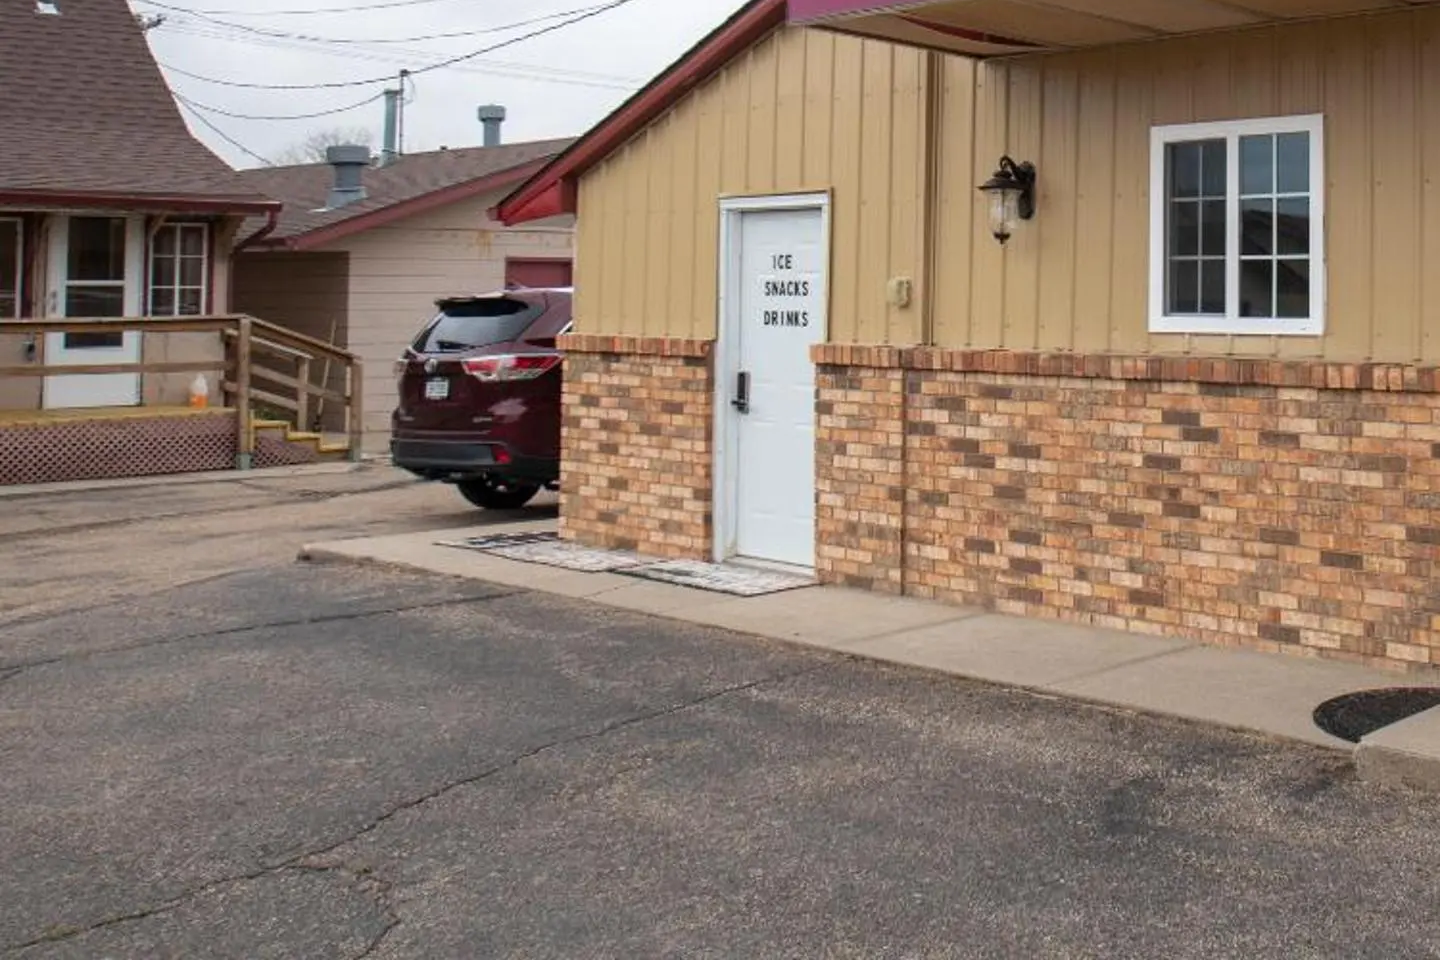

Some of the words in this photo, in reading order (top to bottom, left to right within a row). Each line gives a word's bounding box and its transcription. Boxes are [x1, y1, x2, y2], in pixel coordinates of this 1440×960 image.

[772, 254, 793, 270] ICE
[764, 281, 809, 297] SNACKS
[763, 311, 809, 327] DRINKS
